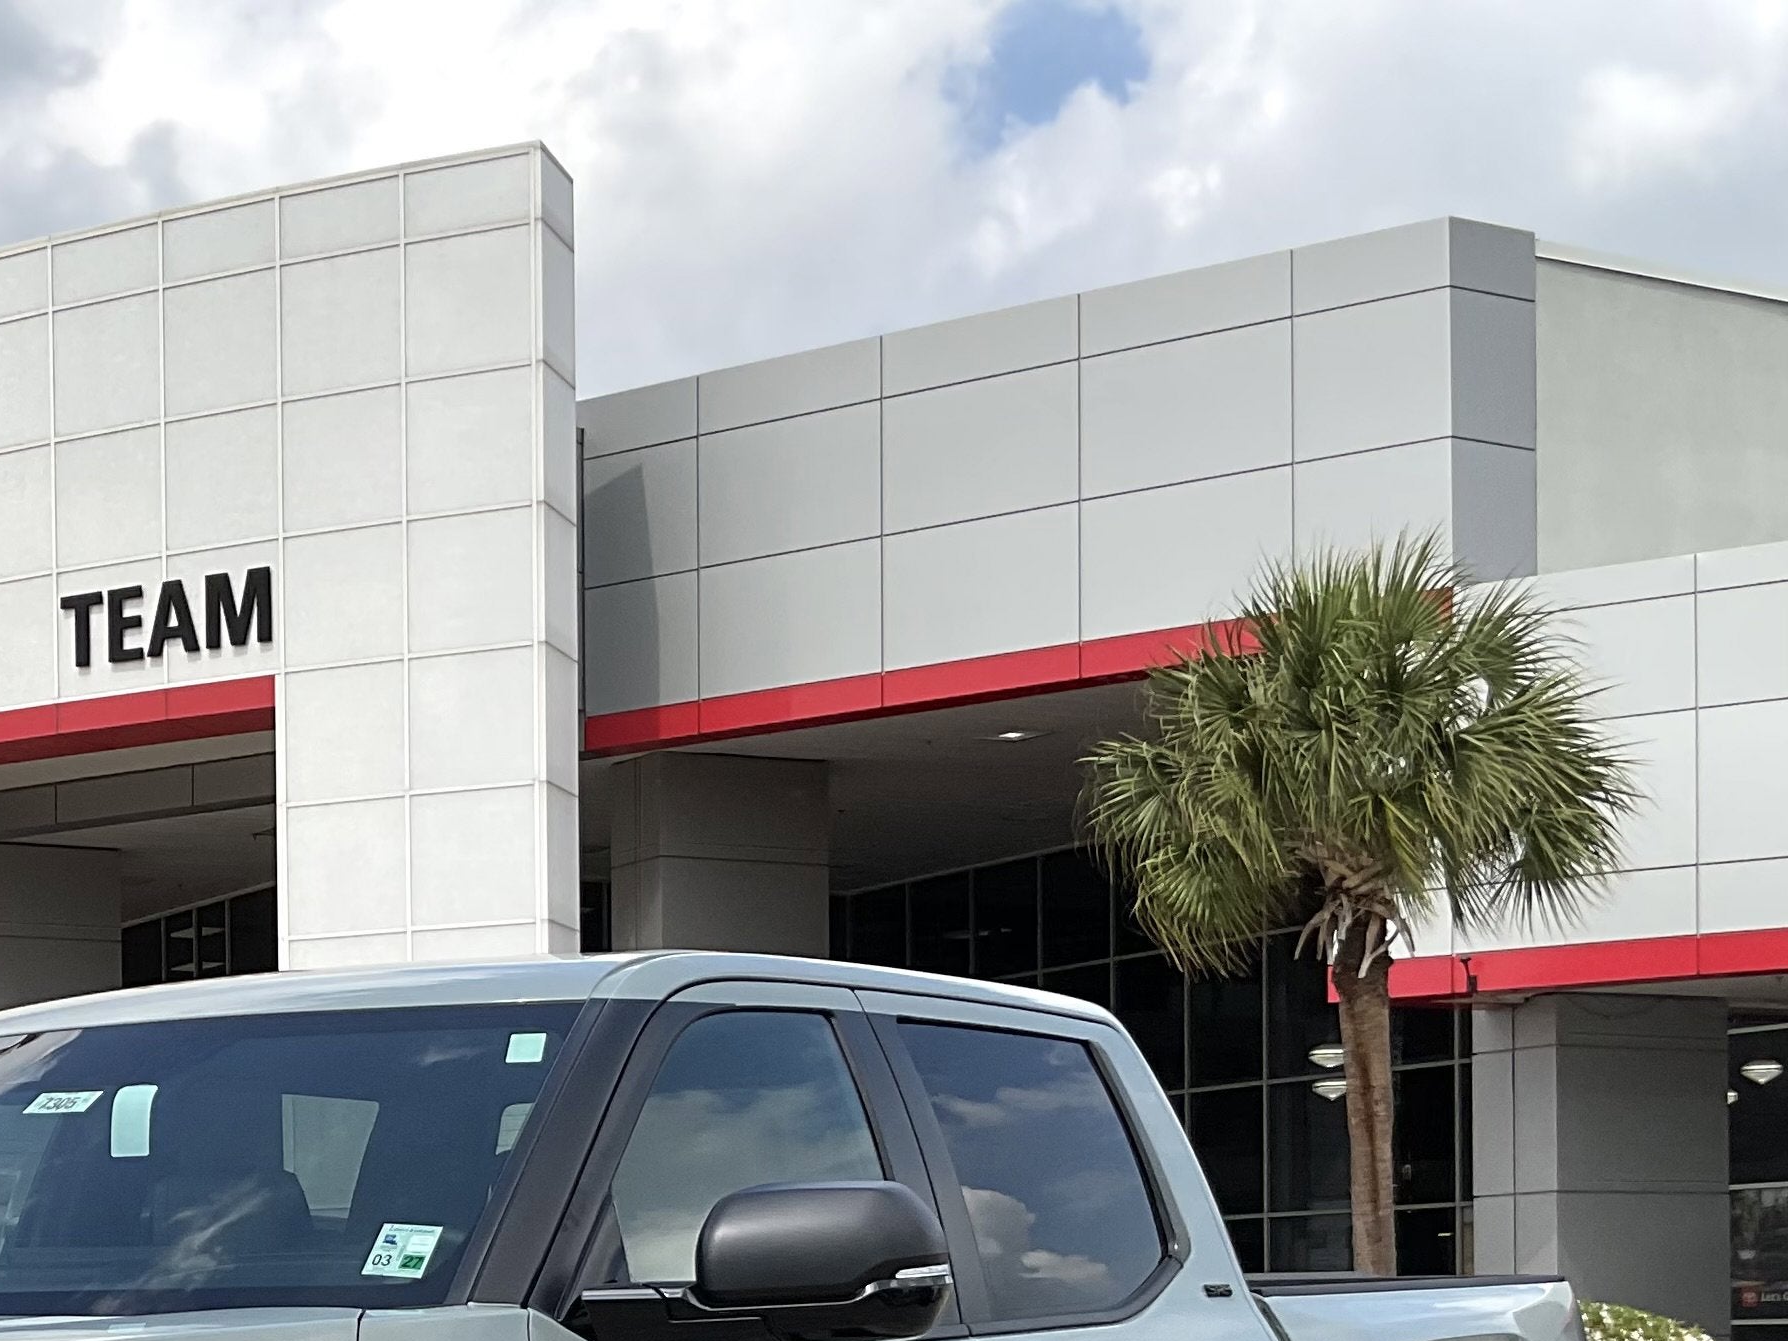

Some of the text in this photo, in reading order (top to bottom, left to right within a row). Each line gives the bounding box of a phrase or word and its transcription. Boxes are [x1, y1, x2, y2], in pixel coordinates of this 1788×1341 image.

[60, 566, 273, 668] TEAM
[371, 1253, 393, 1267] 03
[400, 1253, 425, 1269] 27
